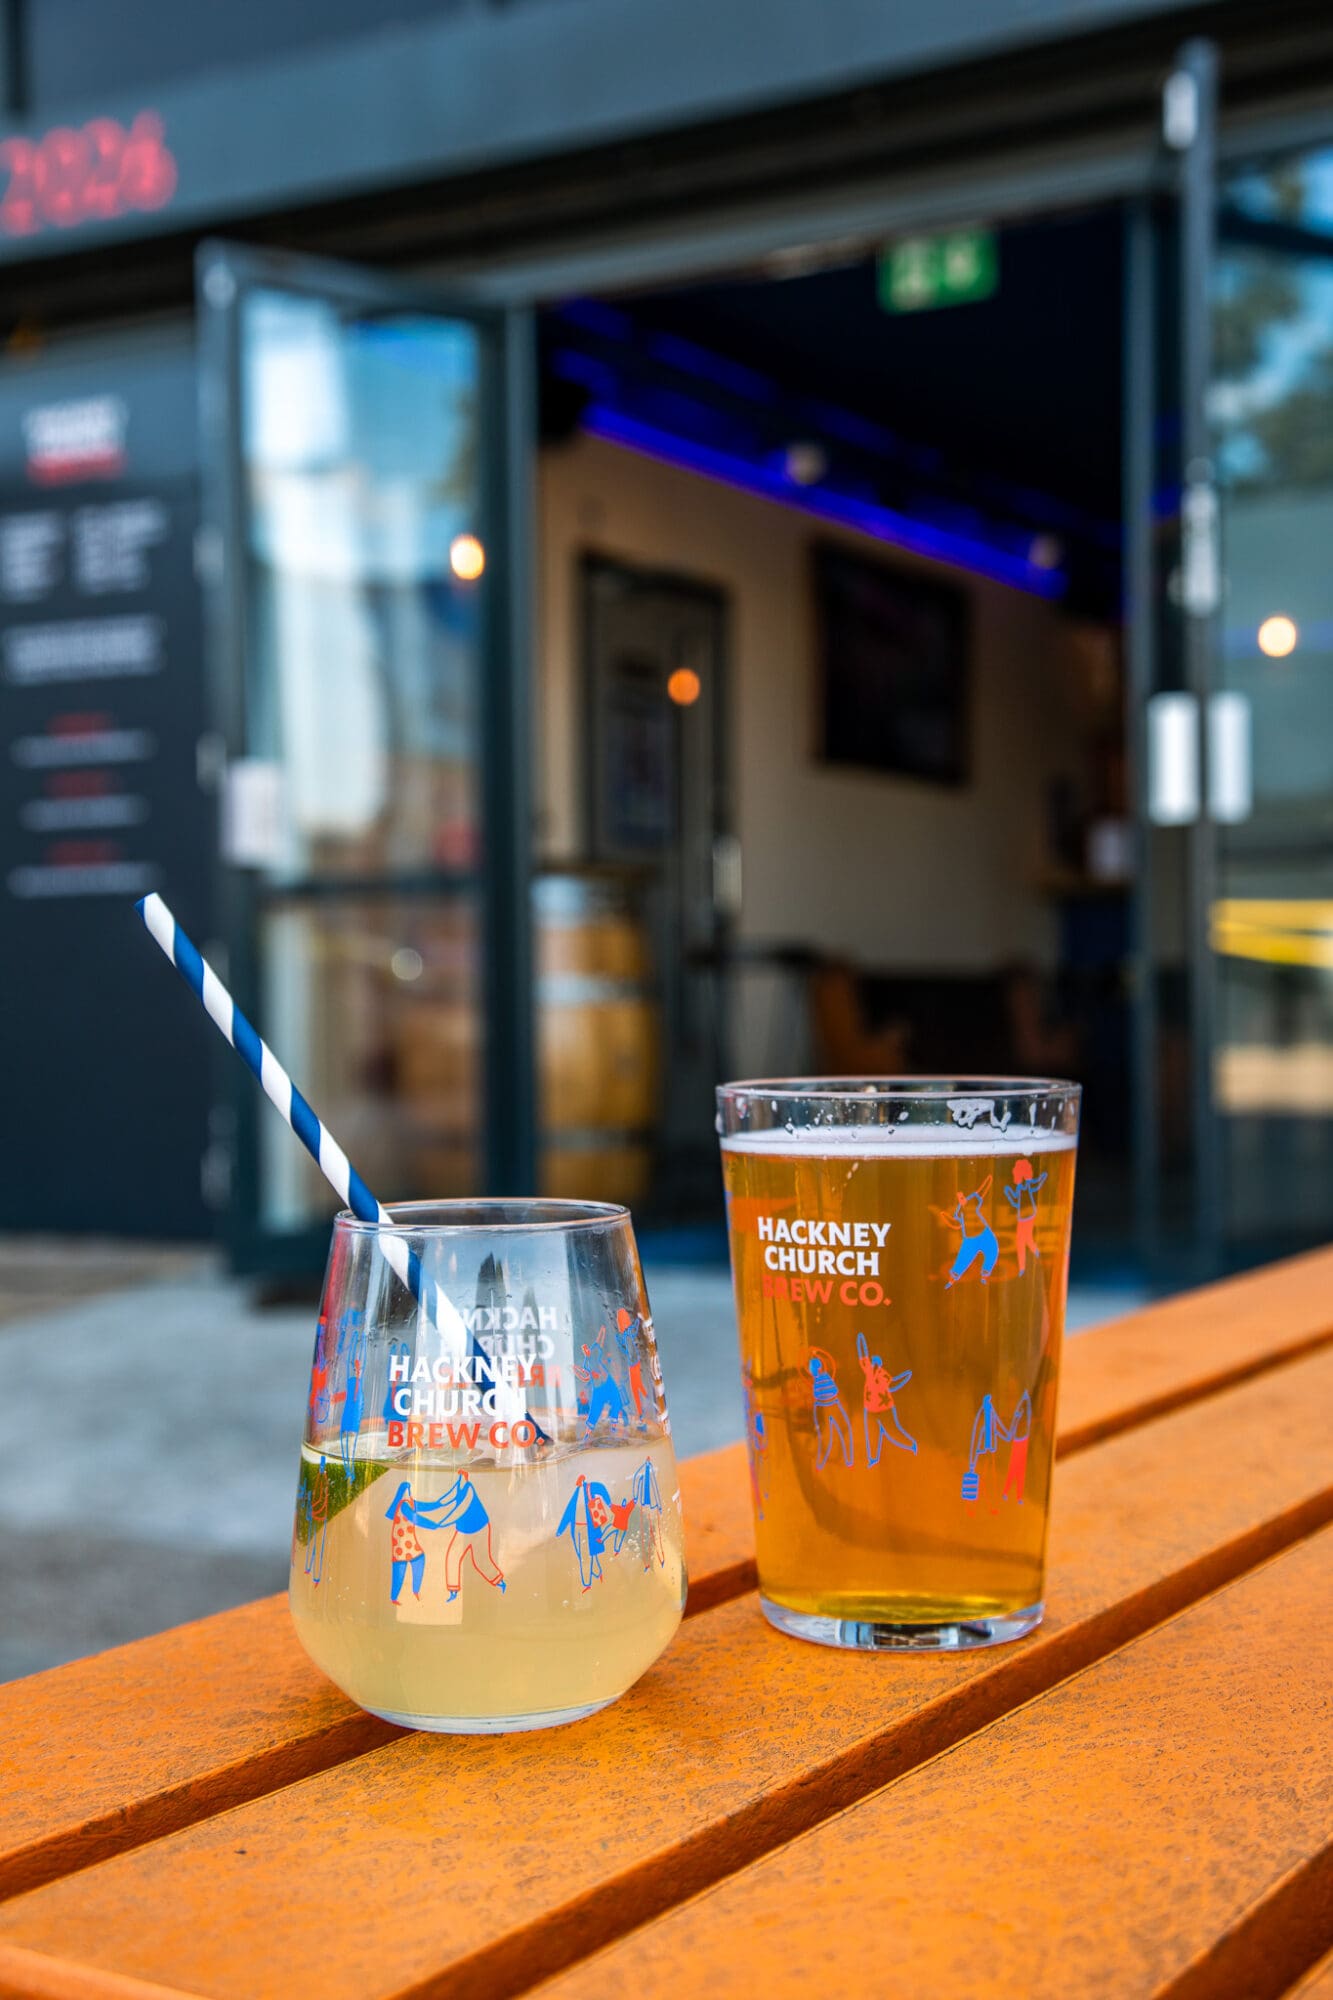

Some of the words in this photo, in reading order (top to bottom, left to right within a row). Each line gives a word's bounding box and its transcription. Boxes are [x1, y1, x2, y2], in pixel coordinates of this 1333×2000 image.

[757, 1216, 891, 1247] HACKNEY
[764, 1245, 880, 1276] CHURCH
[762, 1274, 834, 1304] BREW
[839, 1281, 892, 1307] CO.
[389, 1353, 537, 1384] HACKNEY
[387, 1421, 481, 1450] BREW
[488, 1420, 545, 1450] CO.
